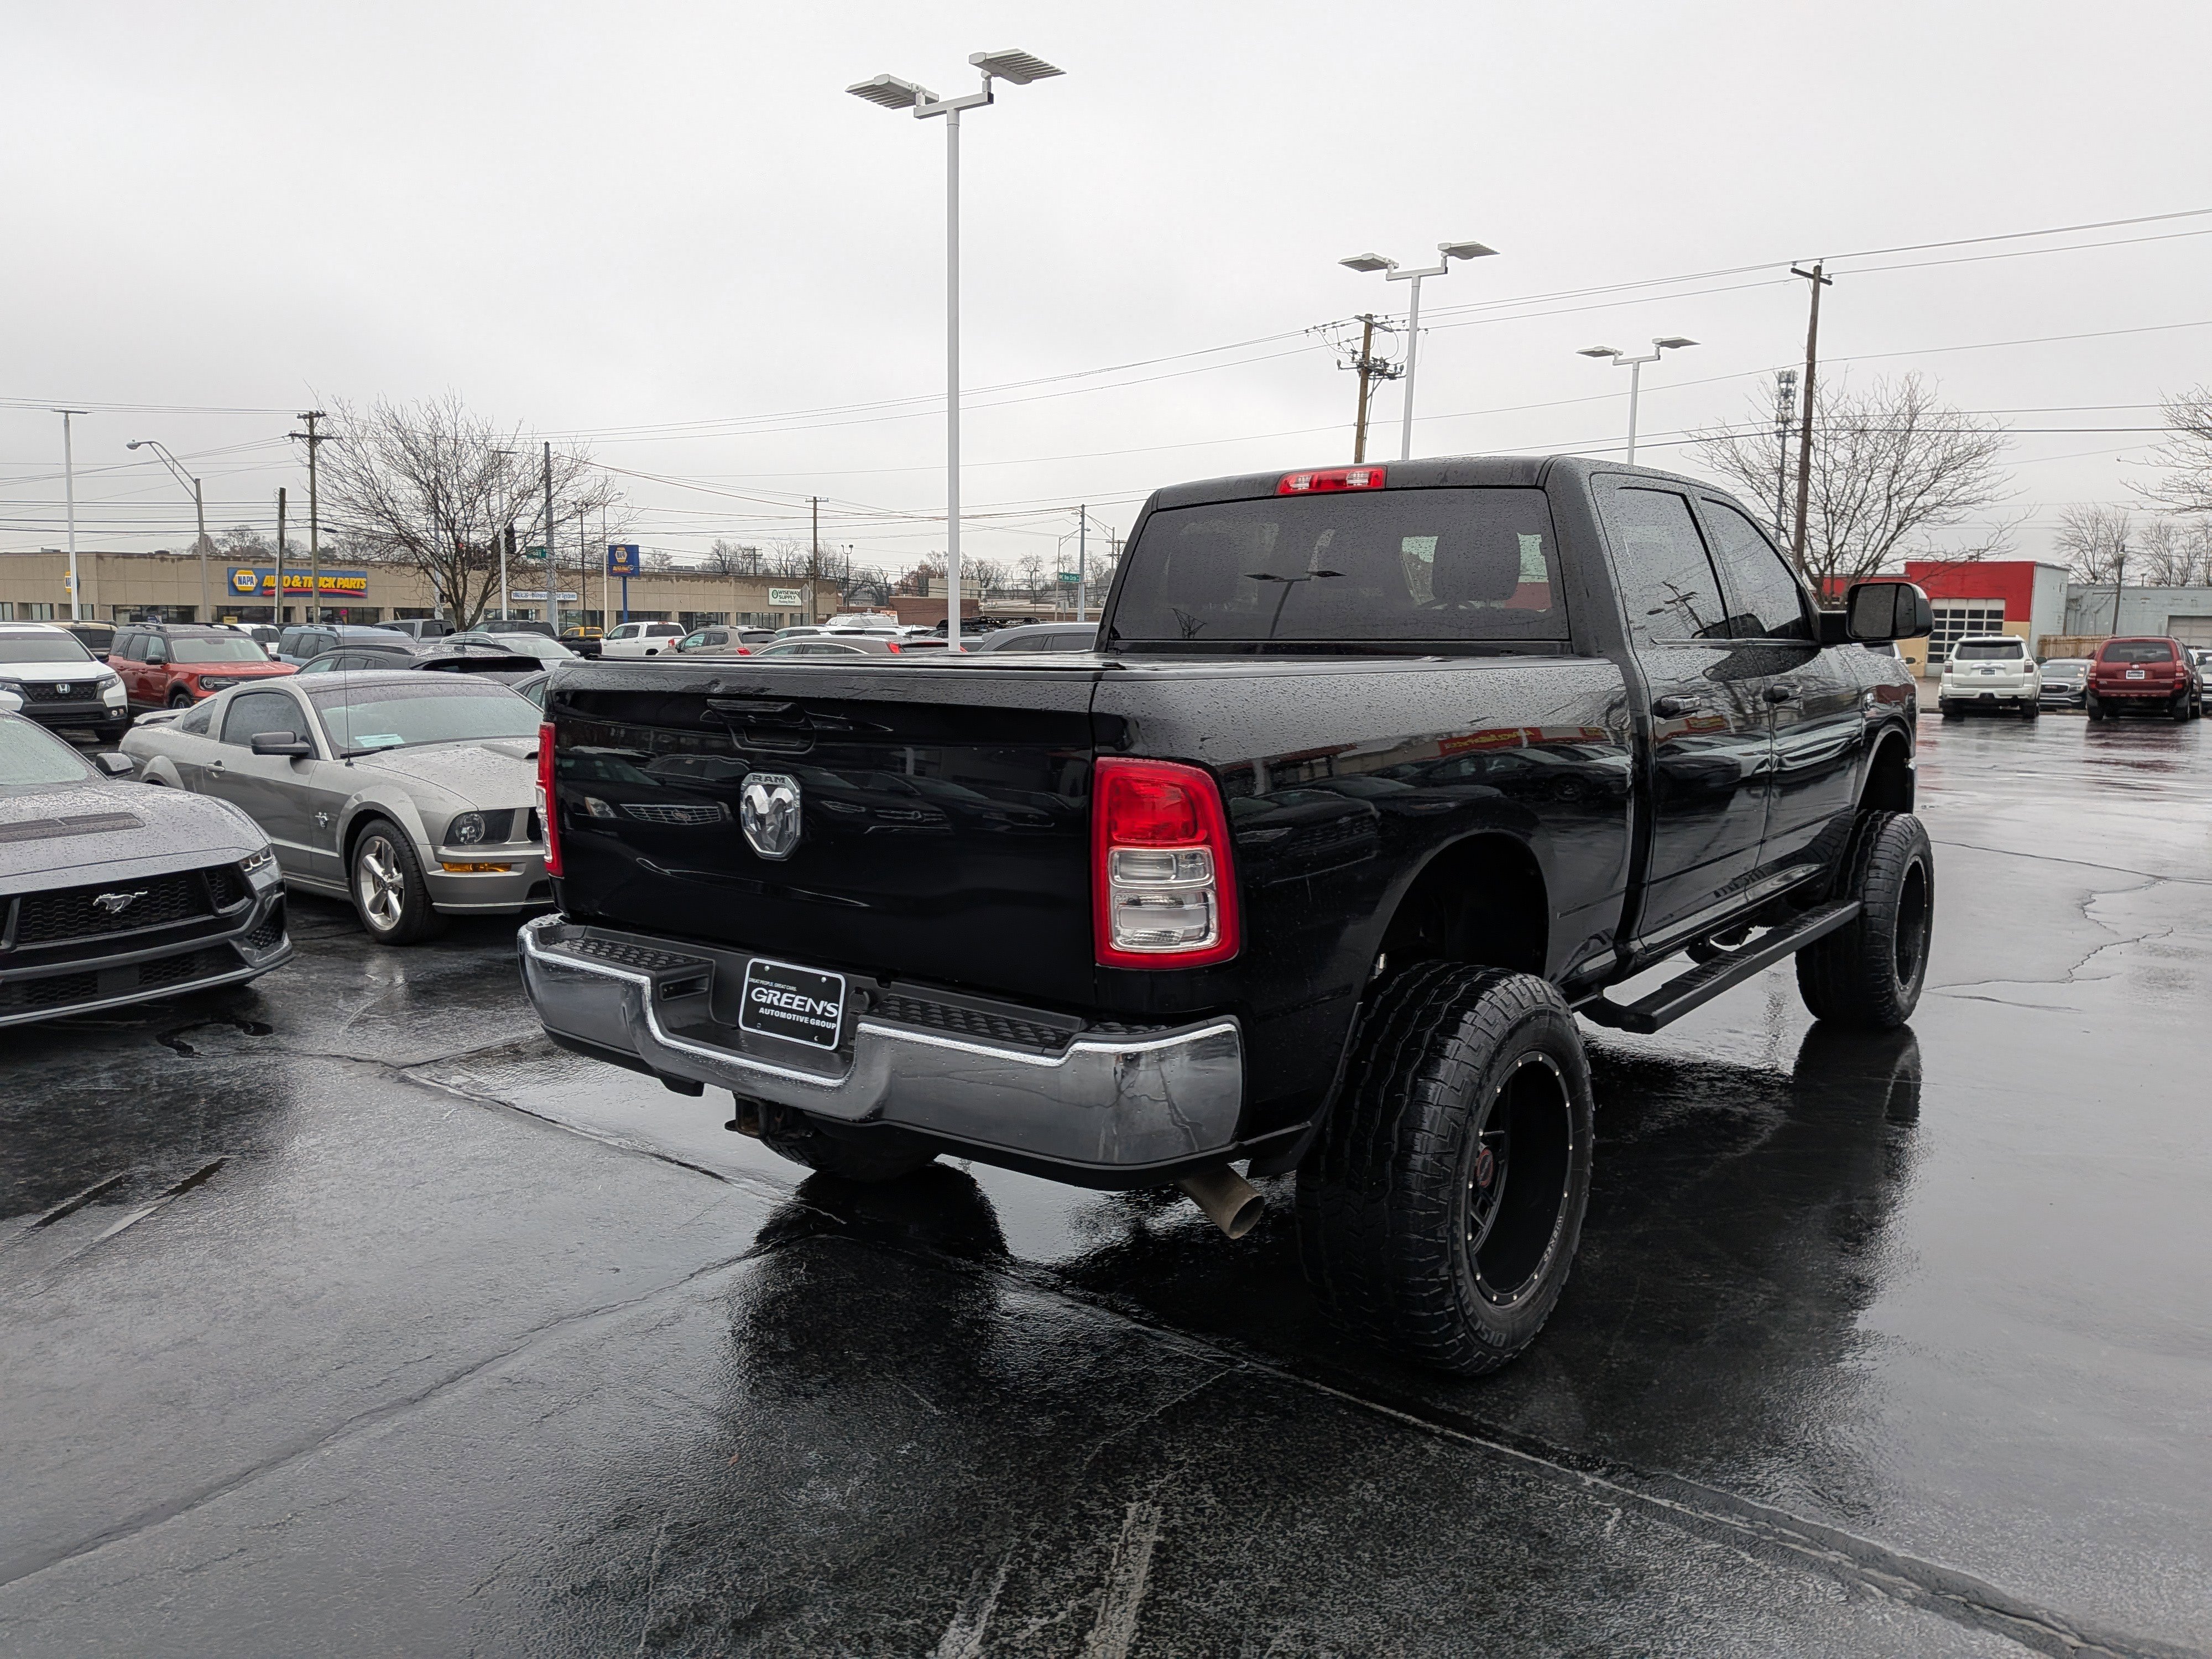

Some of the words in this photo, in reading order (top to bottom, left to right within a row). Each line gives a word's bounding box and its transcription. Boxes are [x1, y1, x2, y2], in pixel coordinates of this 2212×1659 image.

[237, 576, 254, 586] NAPA
[262, 575, 291, 587] AUO
[337, 577, 366, 589] PARTS
[752, 774, 786, 784] RAM
[751, 987, 839, 1018] GREEN'S
[759, 1007, 810, 1024] AUTOMOTIVE
[810, 1018, 837, 1030] GROUP
